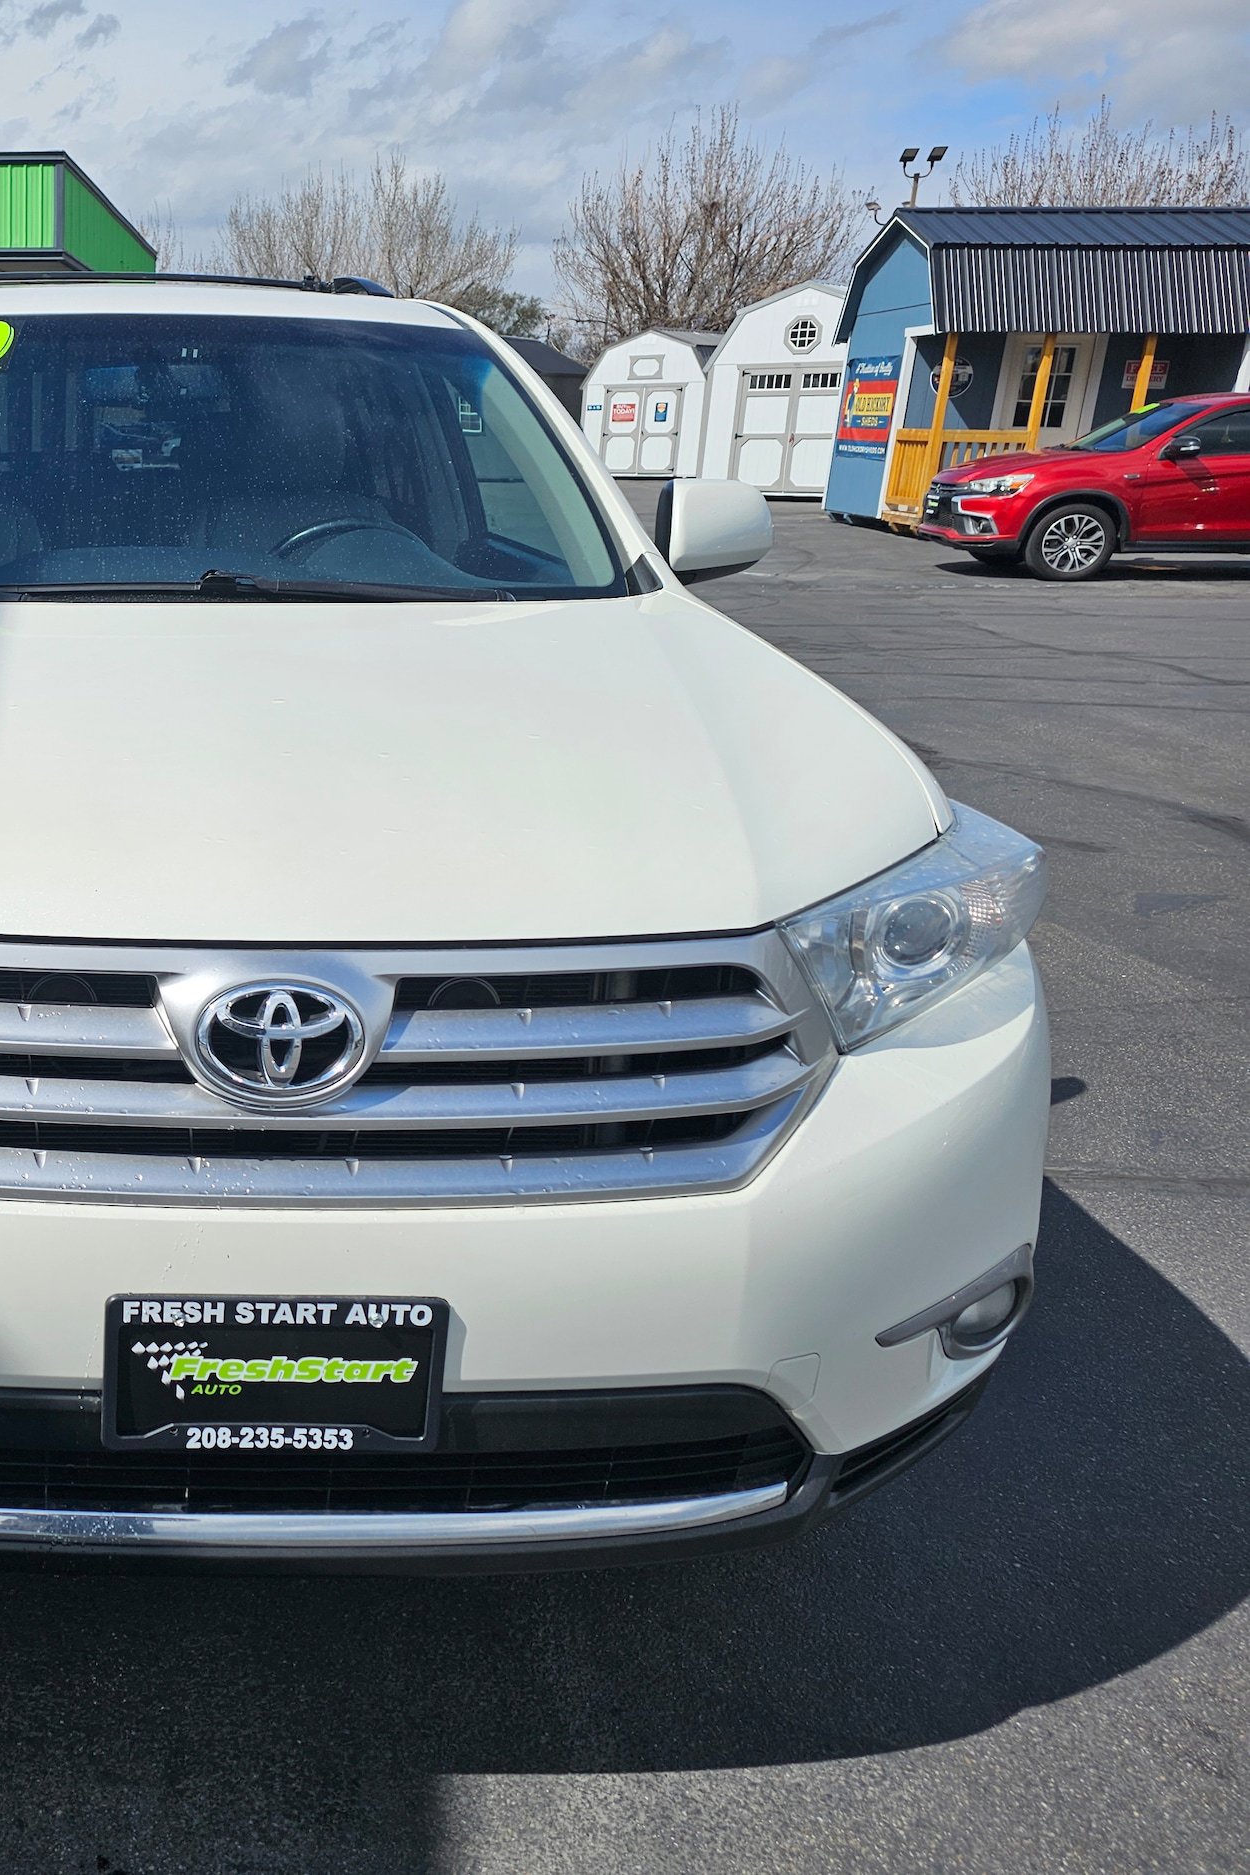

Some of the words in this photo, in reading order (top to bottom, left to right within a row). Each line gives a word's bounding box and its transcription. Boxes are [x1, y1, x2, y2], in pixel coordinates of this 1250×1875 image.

[122, 1301, 226, 1325] FRESH
[234, 1302, 338, 1326] START
[345, 1304, 434, 1327] AUTO
[170, 1355, 419, 1383] FreshStart
[191, 1383, 242, 1396] AUTO
[185, 1427, 354, 1451] 208-235-5353
